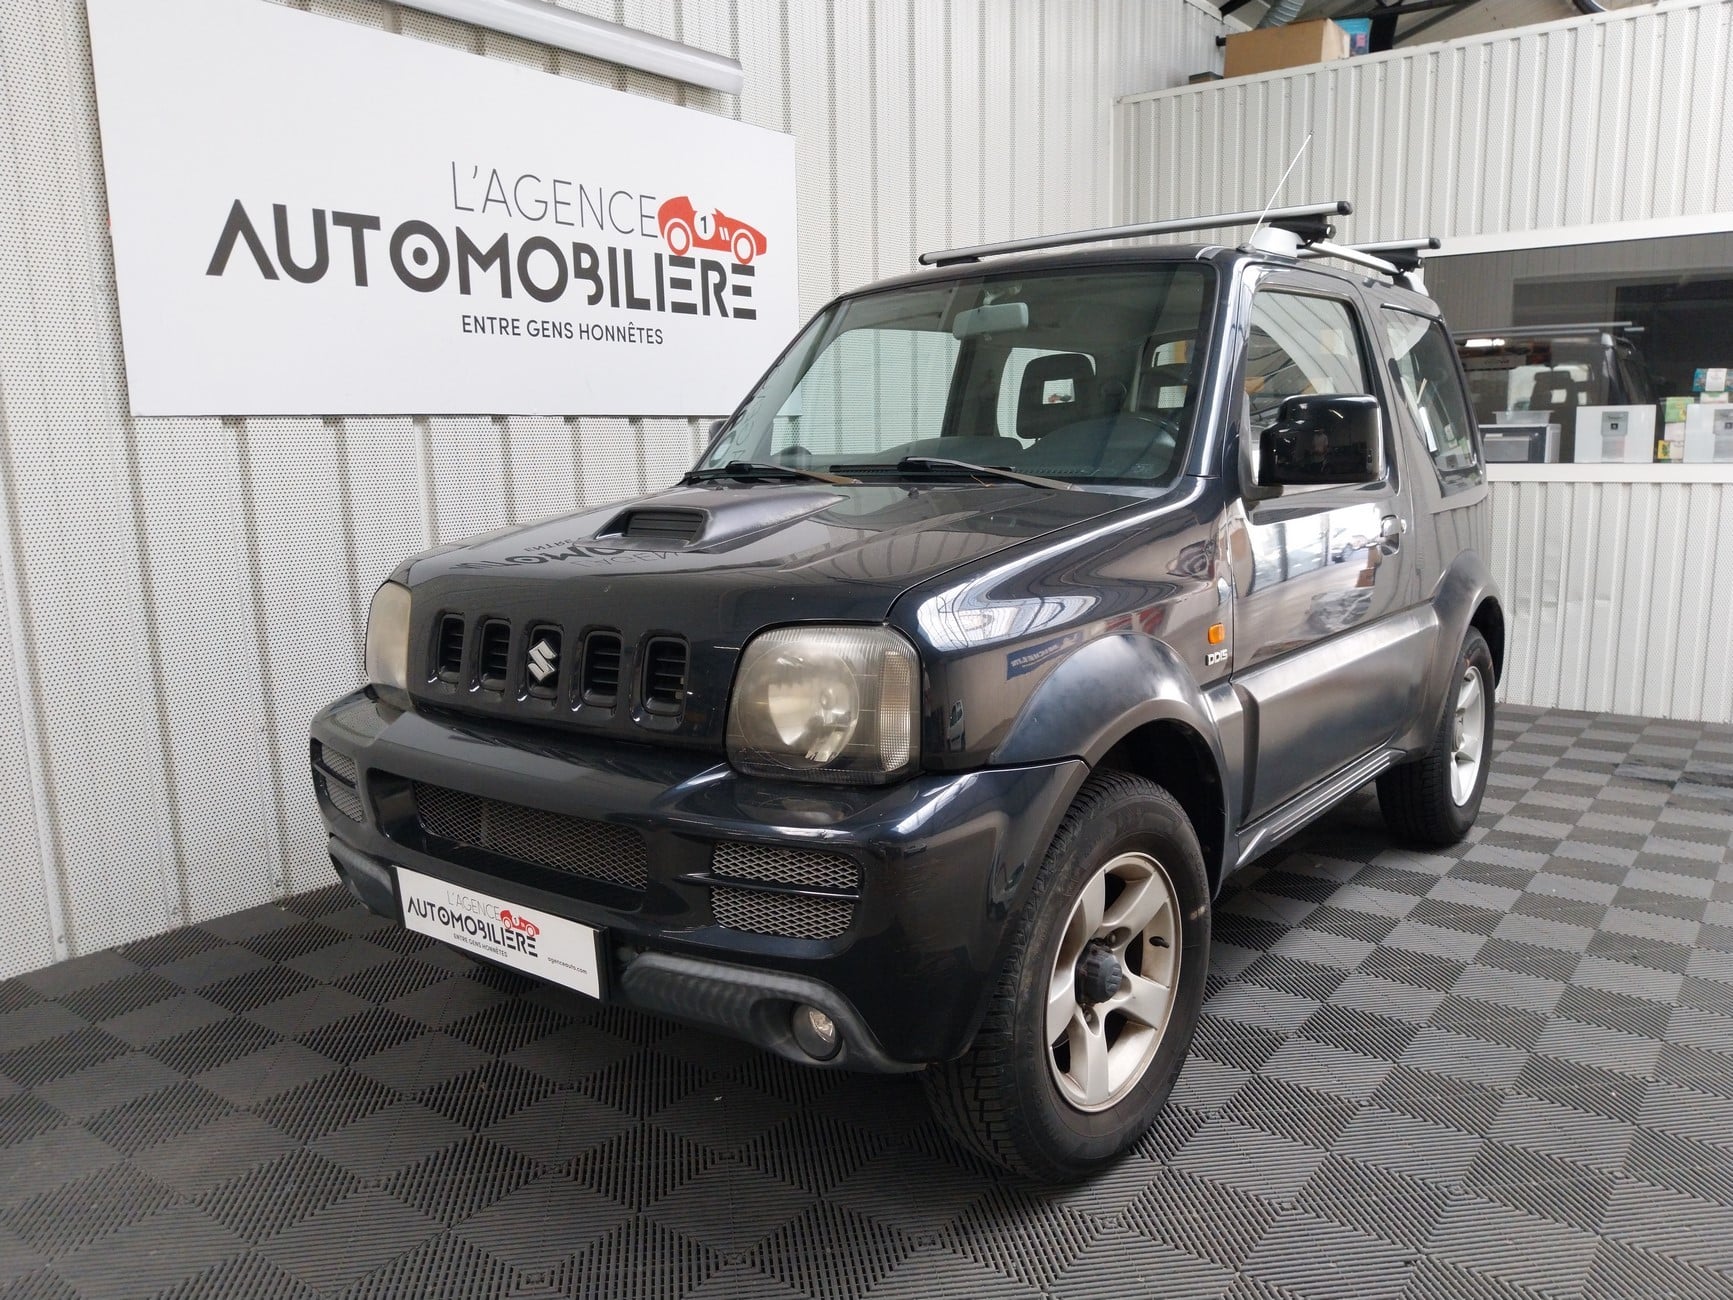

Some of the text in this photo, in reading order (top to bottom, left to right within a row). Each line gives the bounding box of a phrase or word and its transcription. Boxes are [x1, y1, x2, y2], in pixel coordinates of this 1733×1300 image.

[452, 162, 658, 238] L'AGENCE
[701, 216, 708, 233] 1
[462, 315, 663, 344] ENTRE GENS HONNÊTES
[447, 891, 501, 921] L'AGENCE
